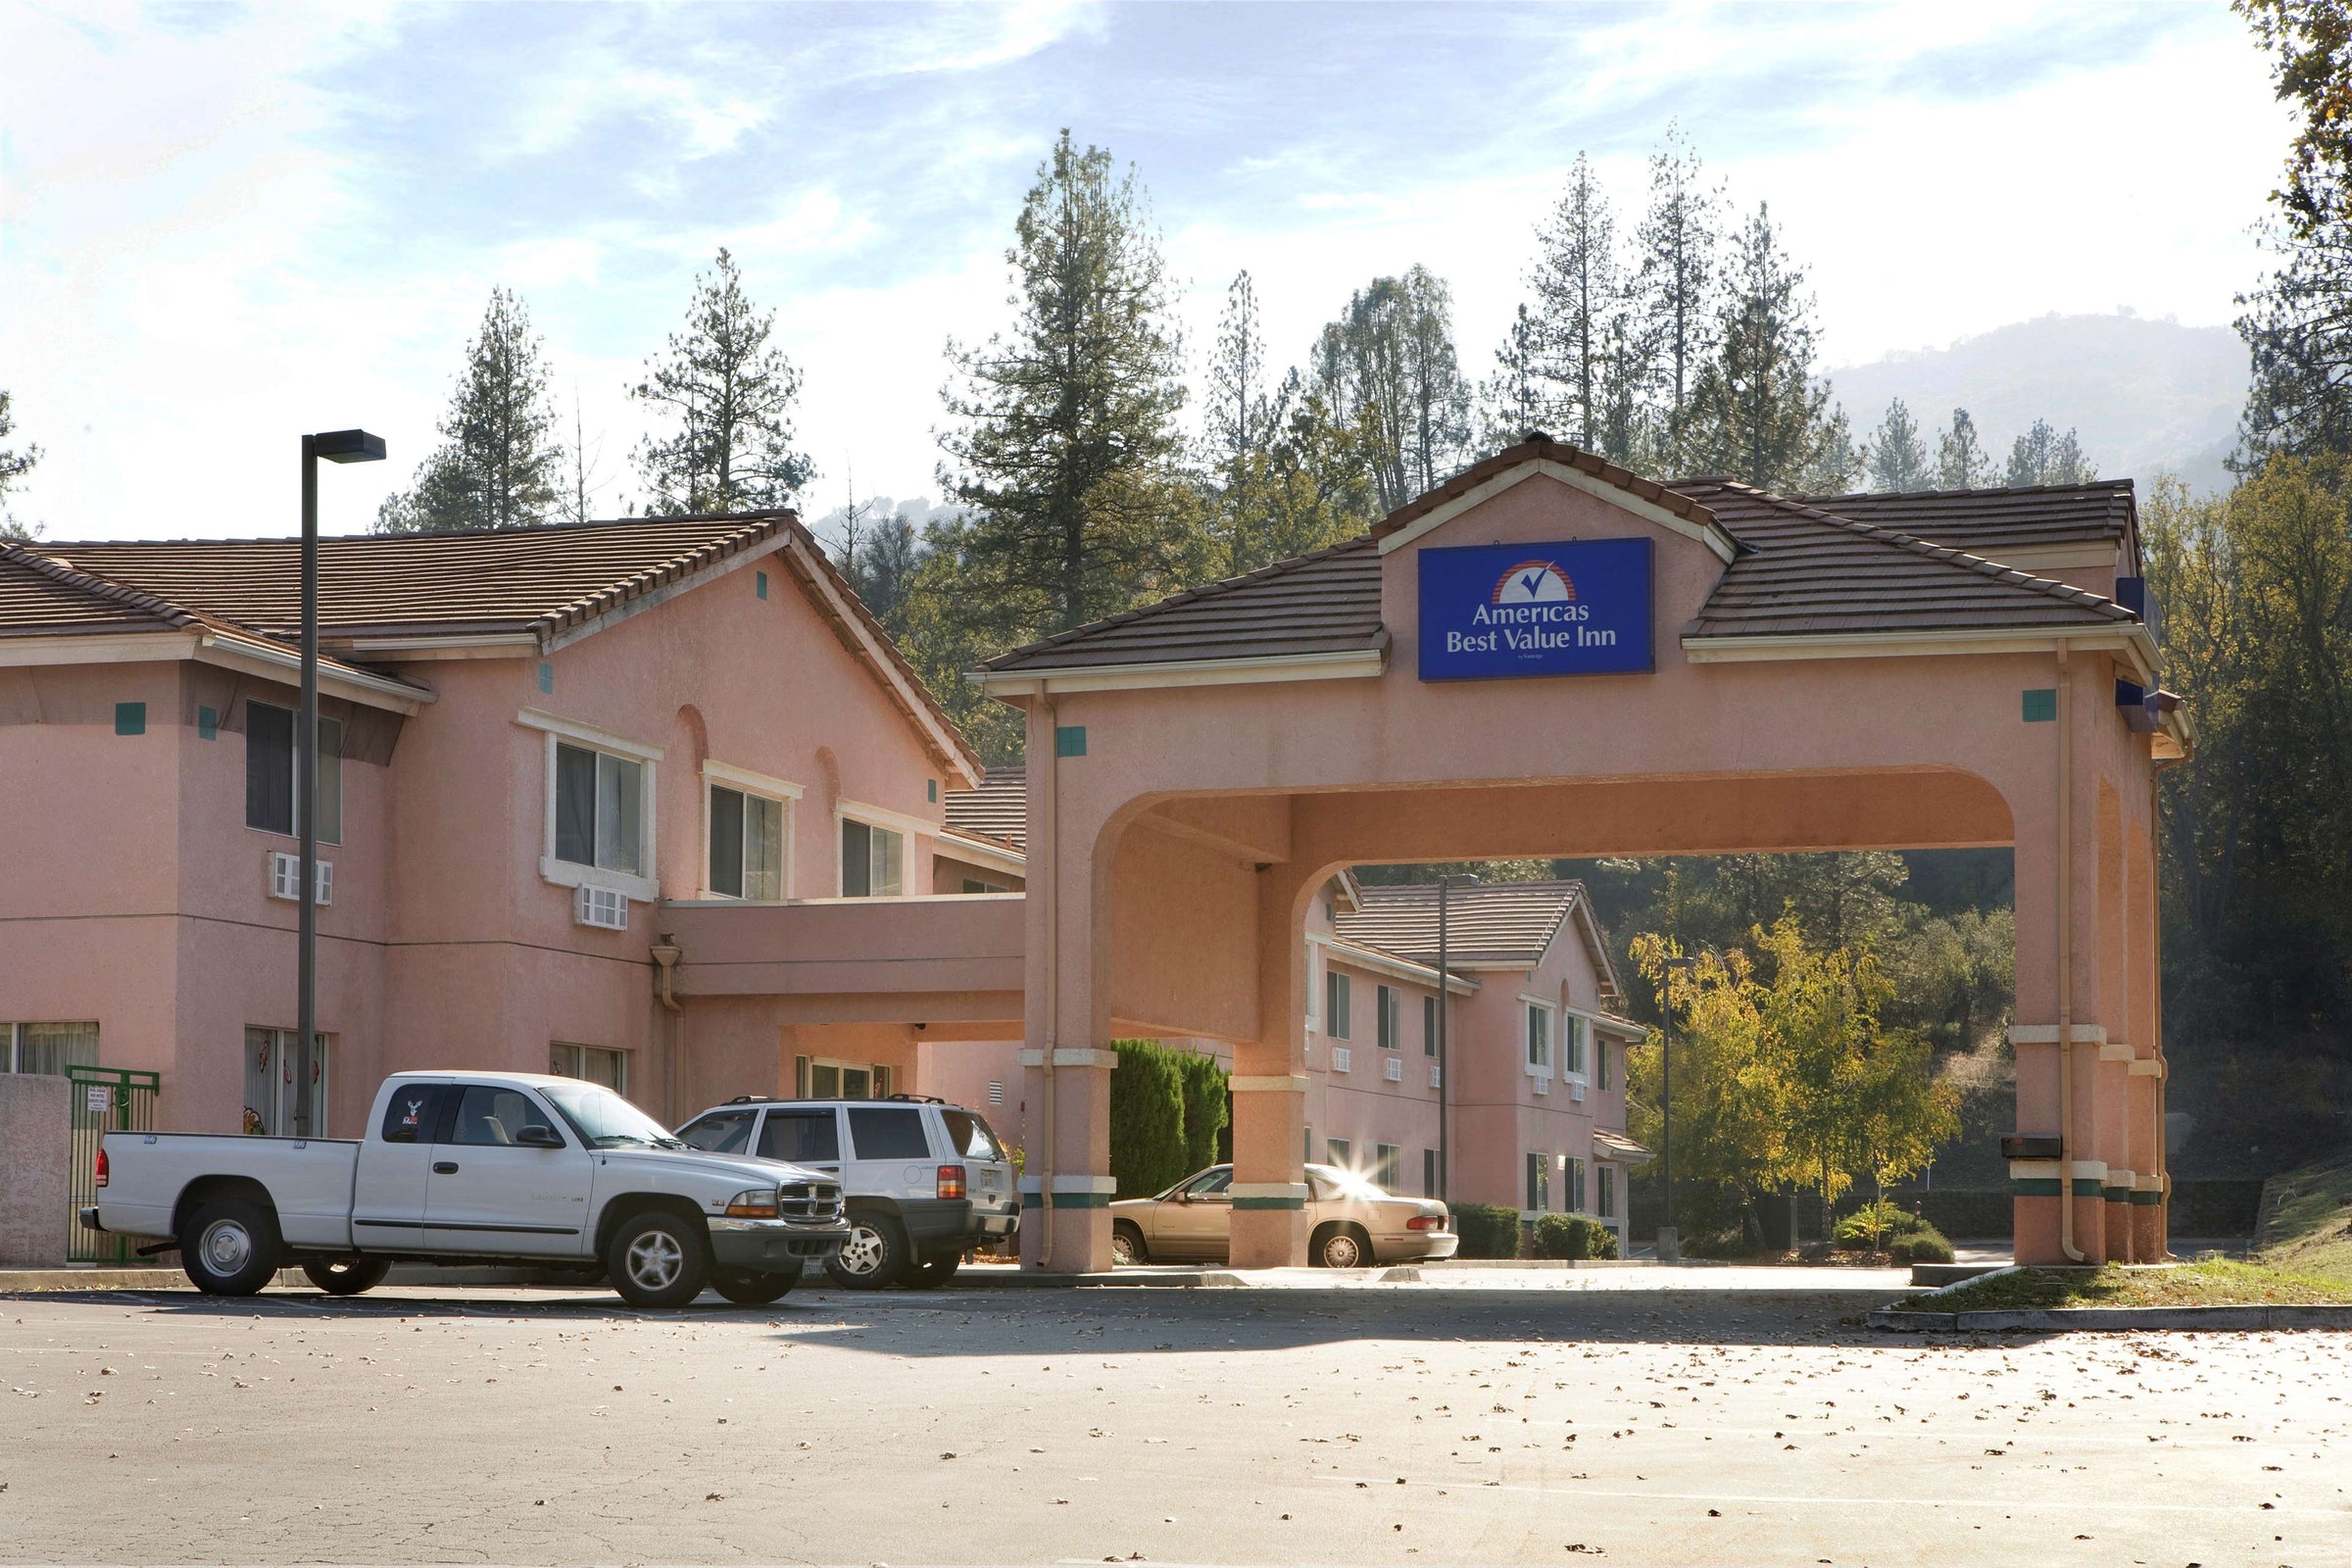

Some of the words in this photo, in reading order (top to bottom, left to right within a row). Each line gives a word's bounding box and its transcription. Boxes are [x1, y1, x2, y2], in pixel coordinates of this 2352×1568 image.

[1472, 604, 1590, 625] Americas
[1446, 630, 1497, 653] Best
[1503, 625, 1570, 650] Value
[1577, 625, 1616, 647] Inn
